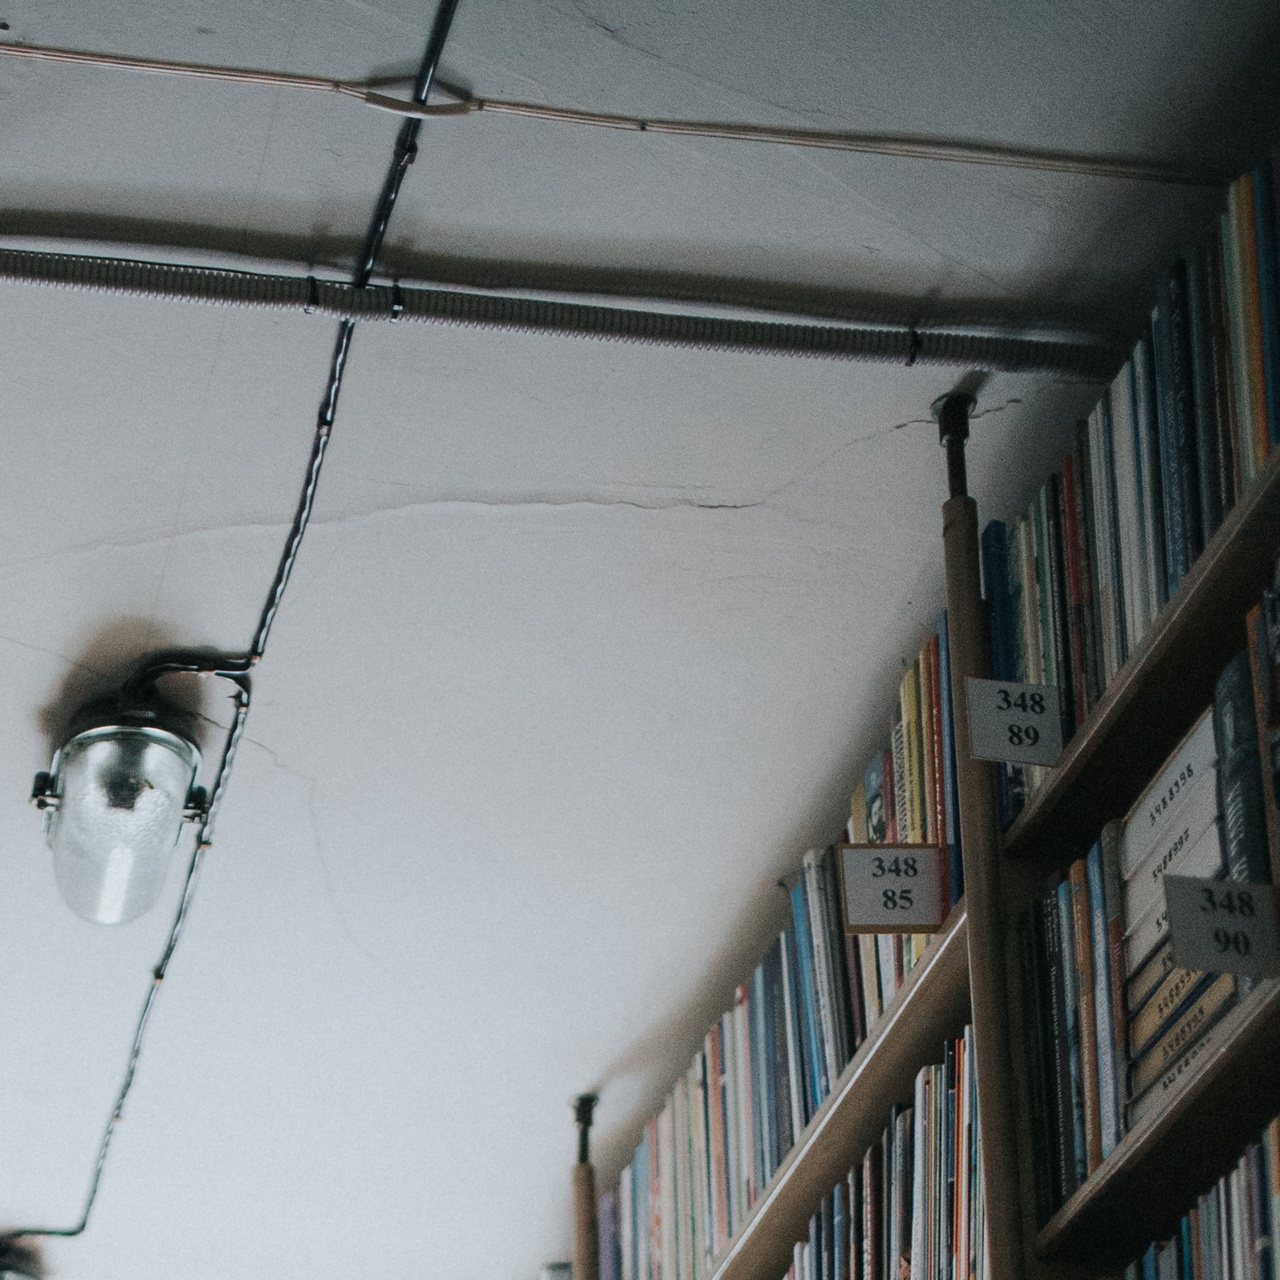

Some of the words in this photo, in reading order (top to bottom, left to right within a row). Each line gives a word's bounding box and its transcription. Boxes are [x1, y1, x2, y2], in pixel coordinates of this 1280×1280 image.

[996, 689, 1046, 715] 348
[1008, 725, 1040, 747] 89
[871, 857, 918, 879] 348
[883, 889, 914, 911] 85
[1200, 887, 1256, 917] 348
[1214, 929, 1250, 956] 90
